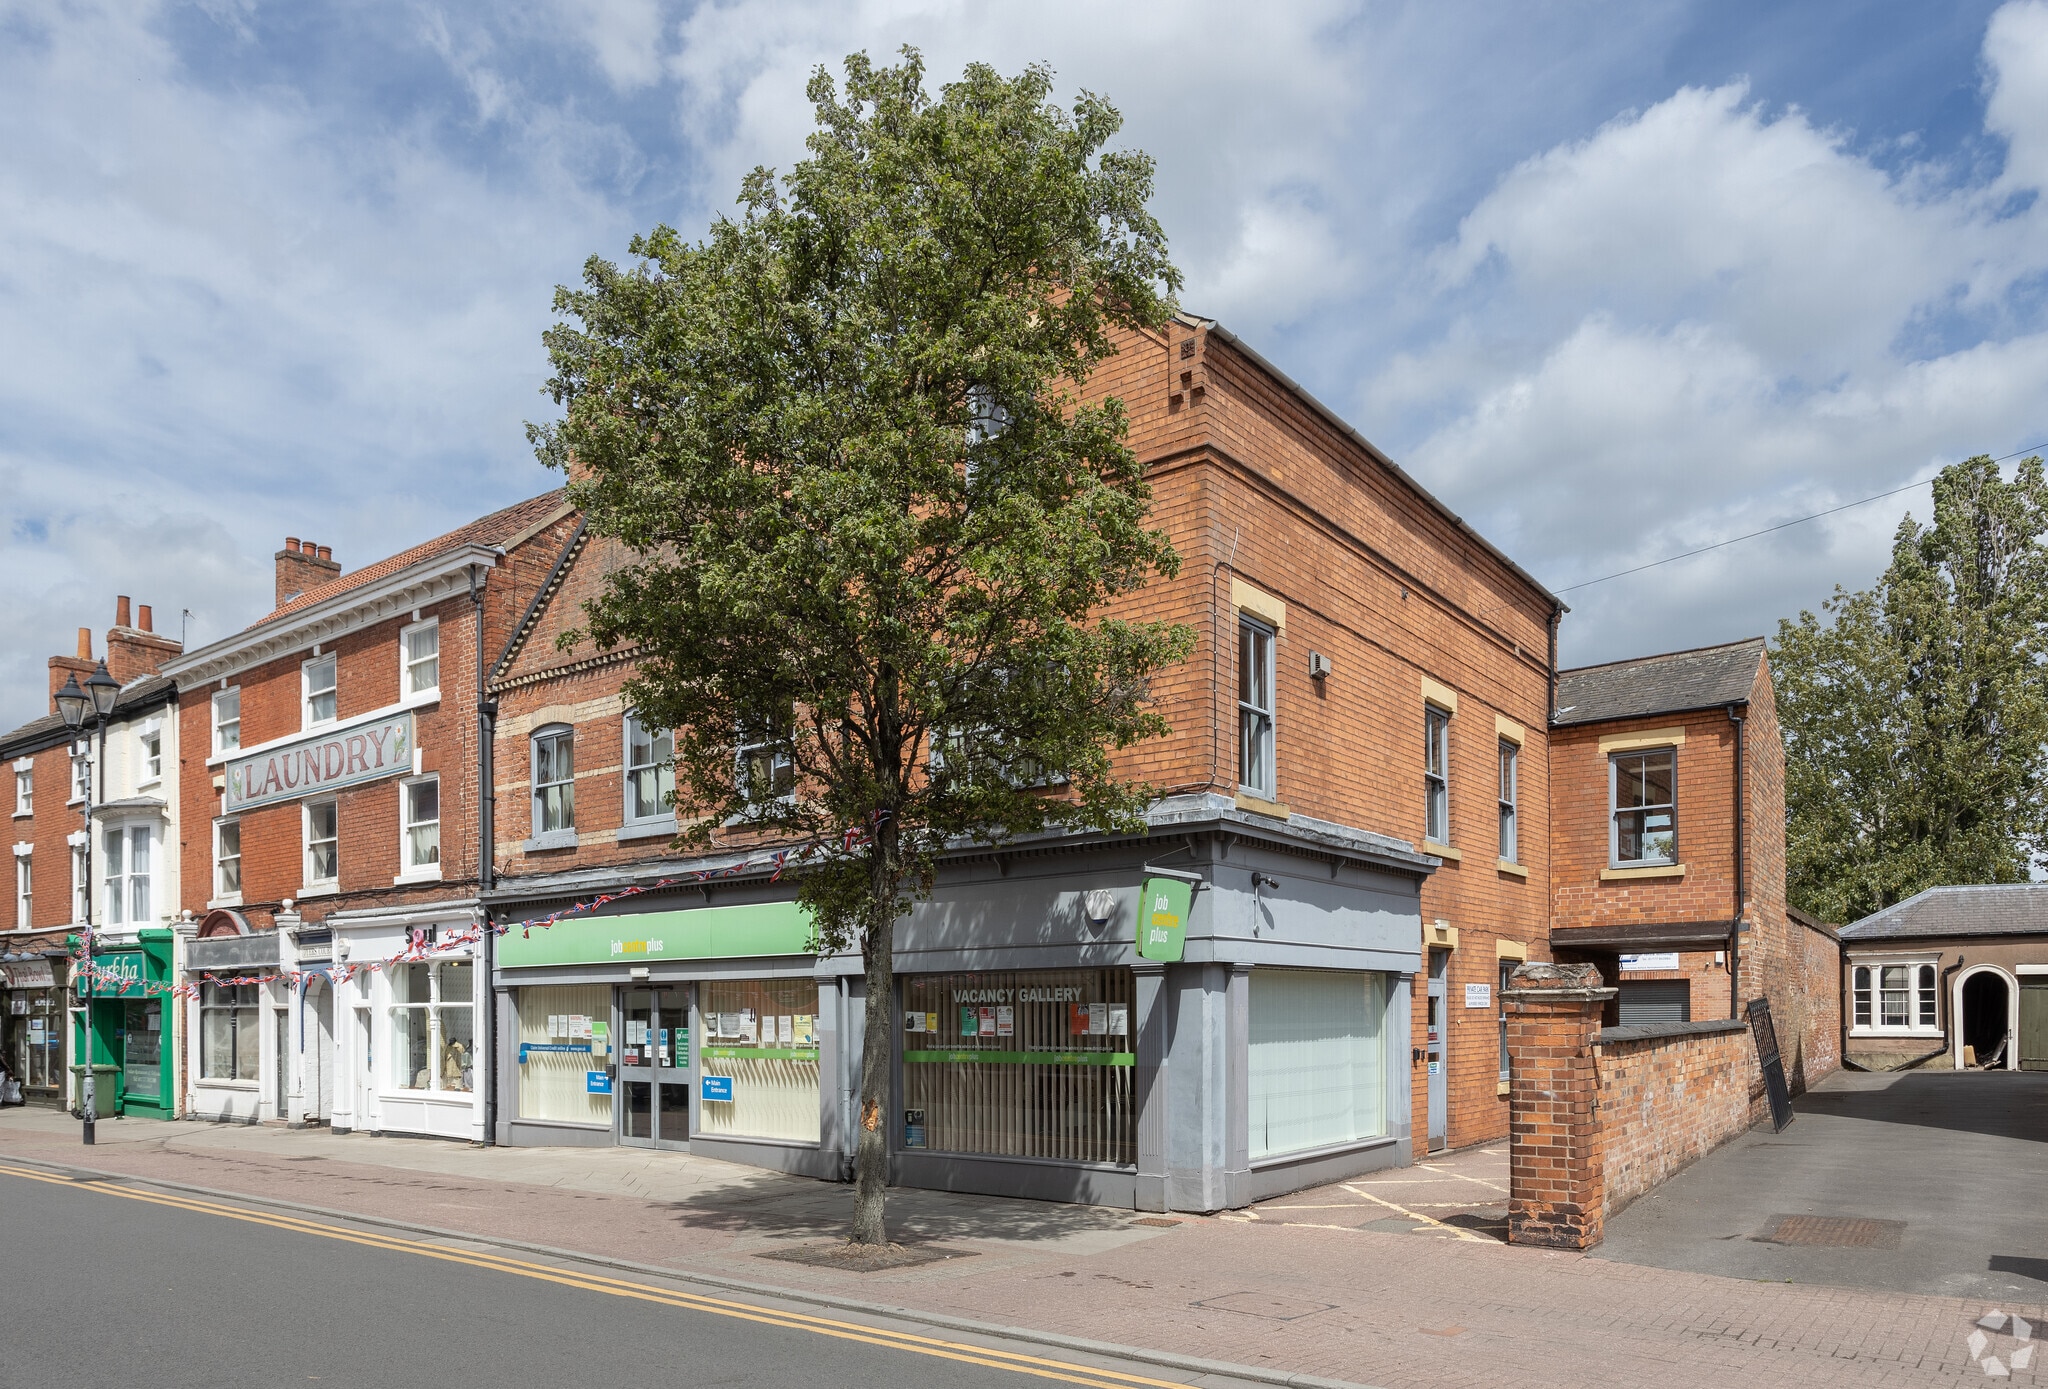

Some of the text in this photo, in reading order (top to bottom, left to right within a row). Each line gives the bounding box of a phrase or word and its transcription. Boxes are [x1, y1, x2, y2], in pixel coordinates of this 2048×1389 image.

[244, 725, 392, 799] LAUNDRY
[1153, 893, 1169, 912] job
[1149, 927, 1168, 945] plus
[610, 937, 664, 957] jobcentreplus
[953, 987, 1082, 1003] VACANCY GALLERY
[710, 1086, 728, 1094] Entrance
